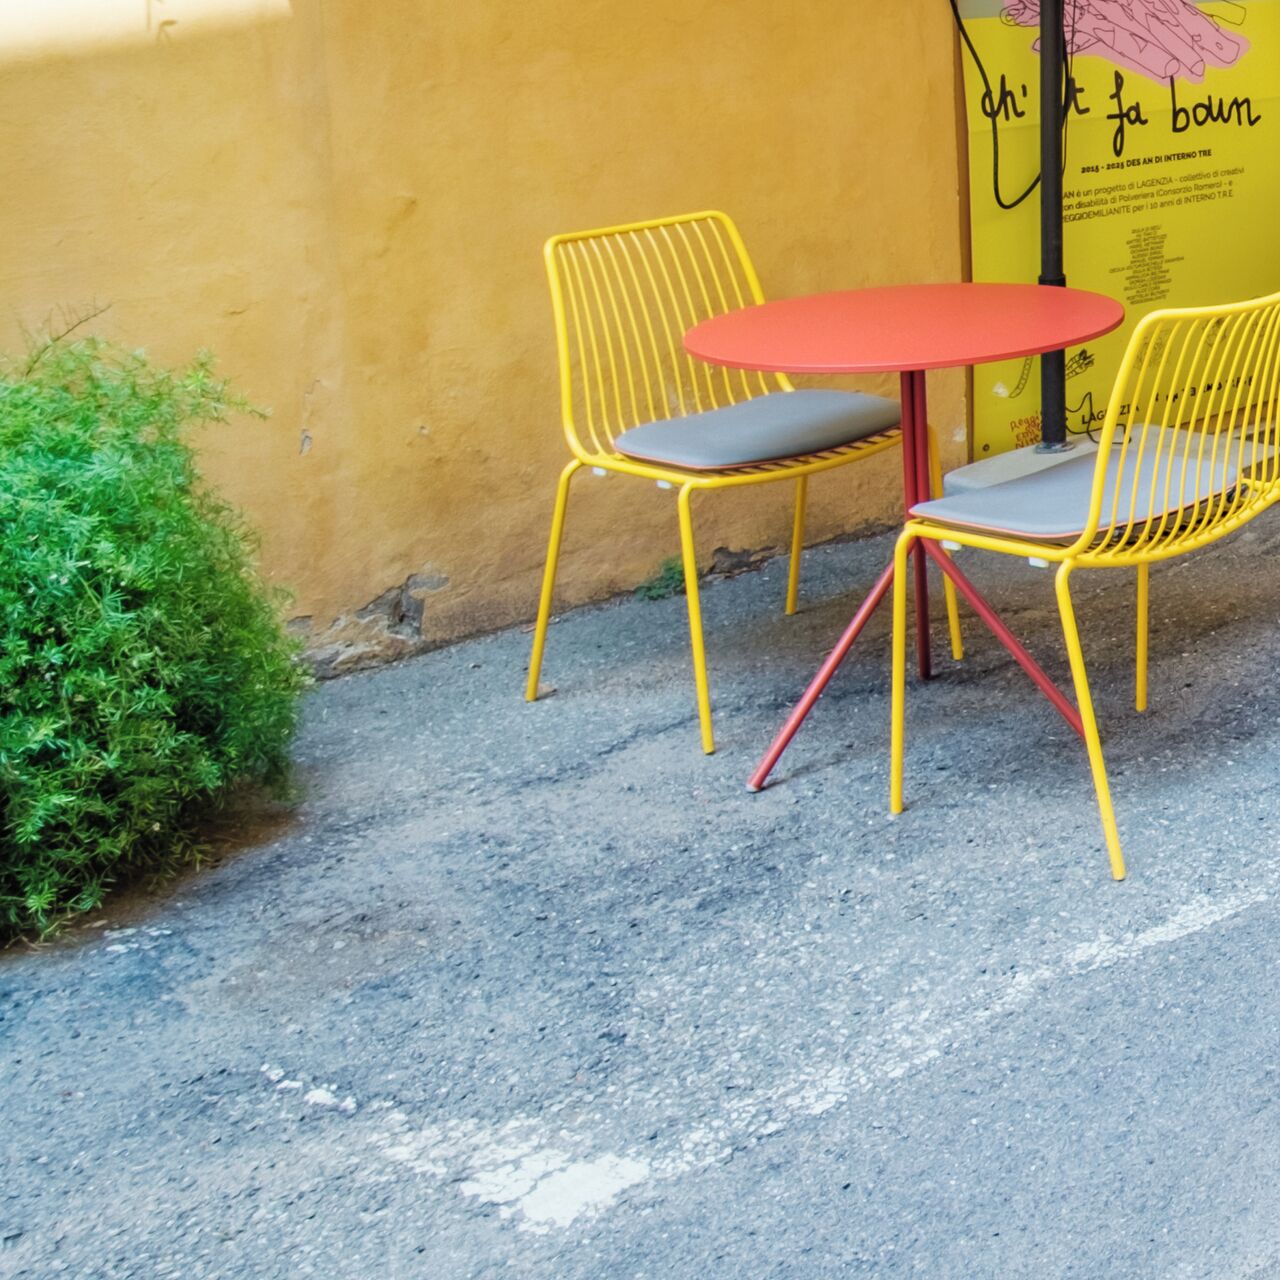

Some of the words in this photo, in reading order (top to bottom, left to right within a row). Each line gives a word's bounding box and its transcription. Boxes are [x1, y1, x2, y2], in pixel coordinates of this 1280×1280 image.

[1126, 158, 1141, 168] DES
[1142, 157, 1153, 166] AN
[1164, 151, 1197, 162] INTERNO
[1198, 149, 1212, 158] TRE
